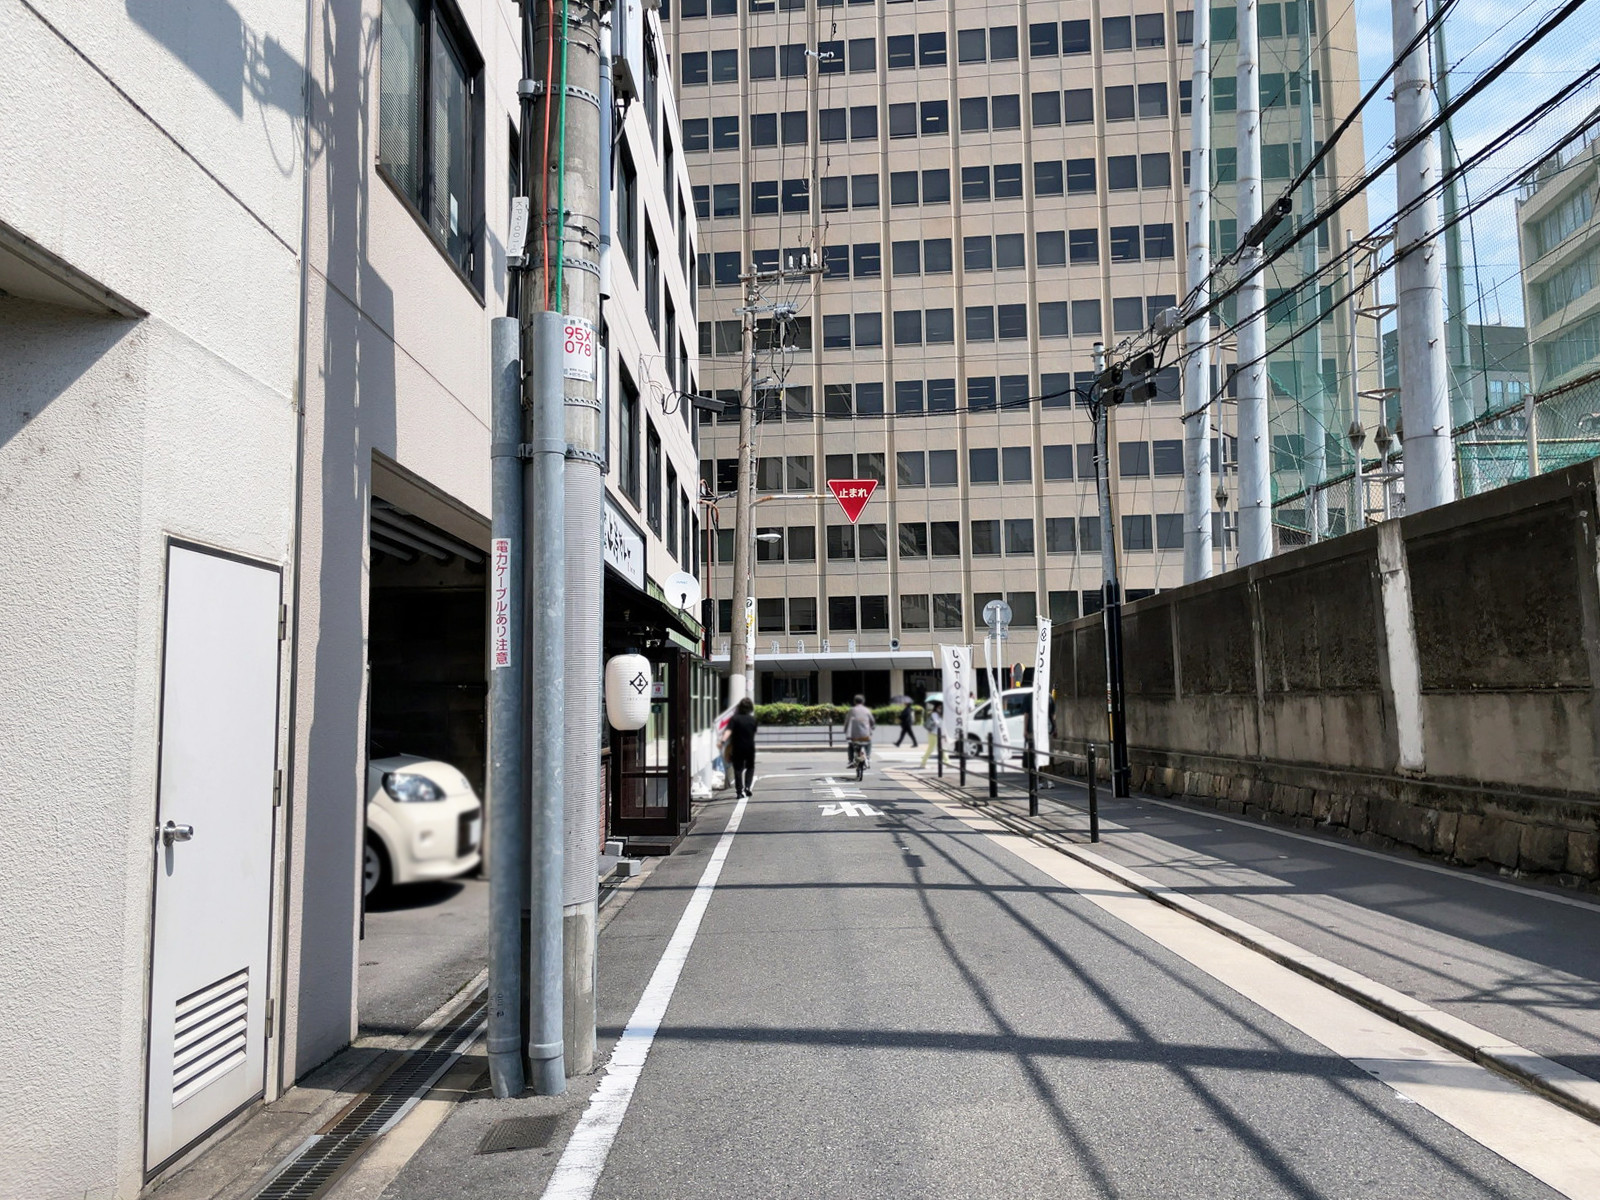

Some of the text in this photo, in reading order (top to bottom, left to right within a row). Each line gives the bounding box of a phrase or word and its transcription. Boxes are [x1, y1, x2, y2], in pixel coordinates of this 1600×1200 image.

[564, 326, 592, 343] 95X
[564, 340, 592, 357] 078
[838, 487, 869, 499] 止まれ
[495, 540, 508, 665] 電力ケーブルあり注意
